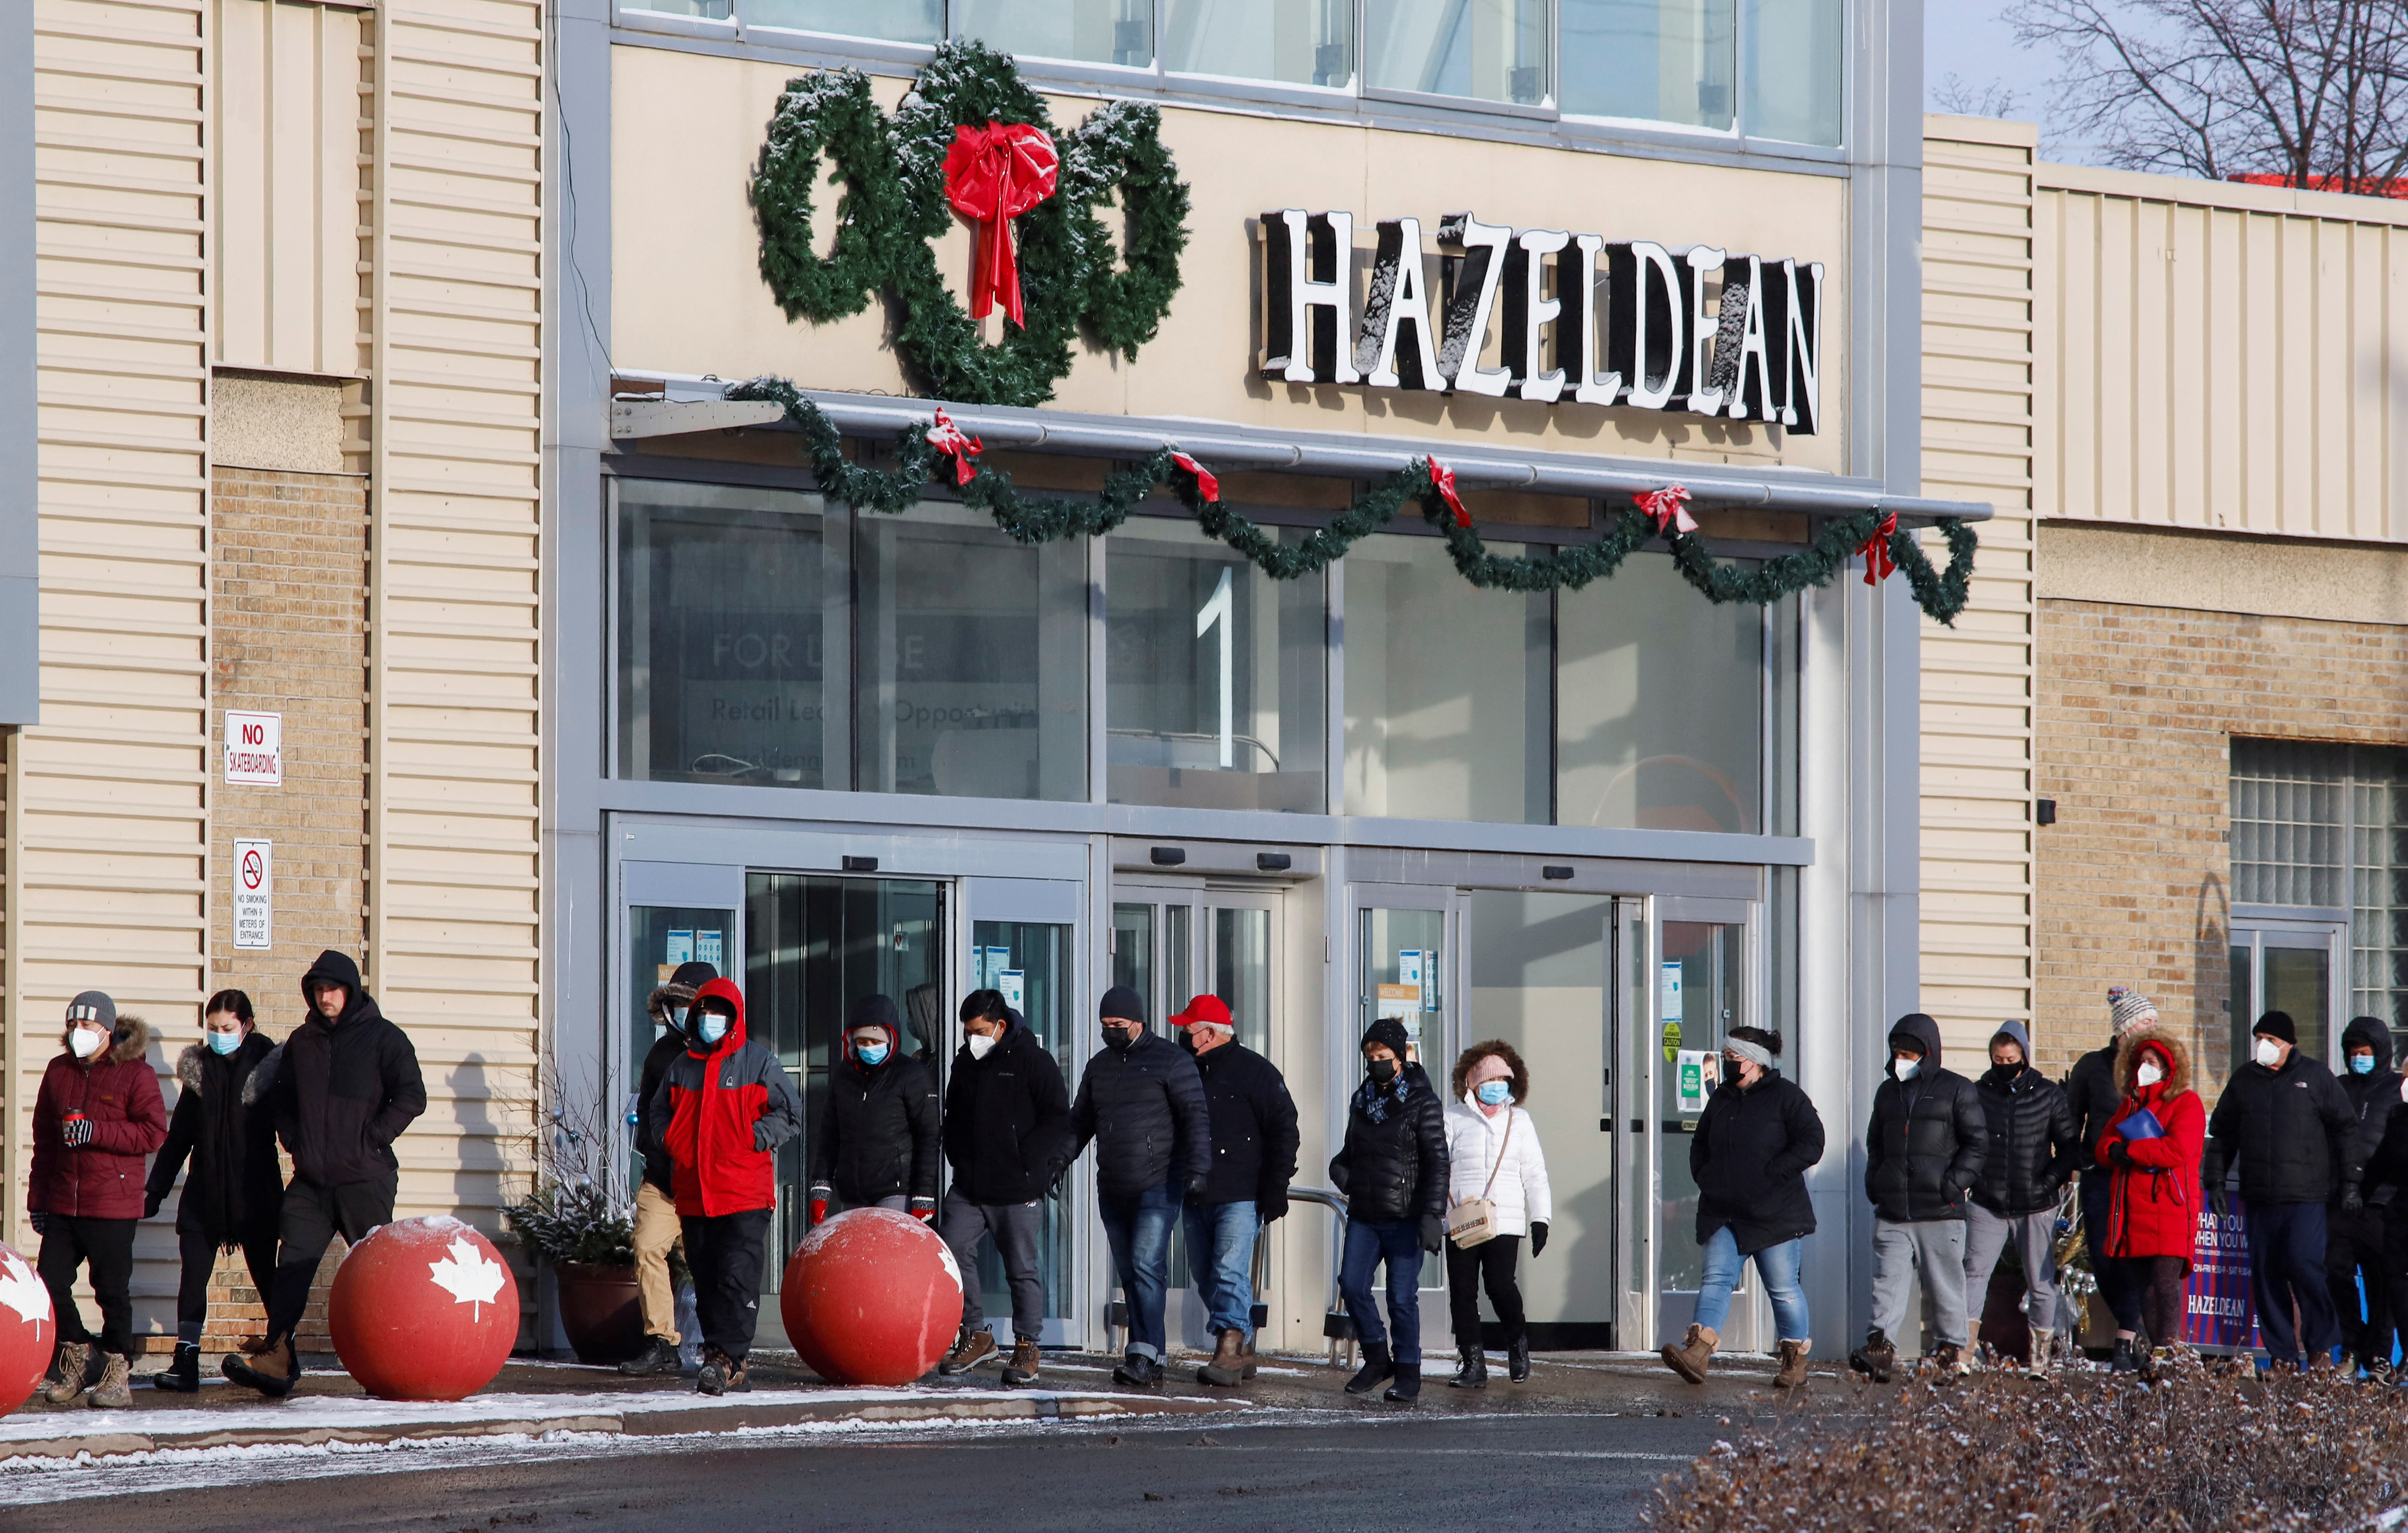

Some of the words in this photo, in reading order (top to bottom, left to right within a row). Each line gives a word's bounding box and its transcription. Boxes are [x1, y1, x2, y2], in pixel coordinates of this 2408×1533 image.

[1274, 209, 1824, 436] HAZELDEAN
[713, 633, 791, 668] FOR
[1197, 566, 1232, 767] 1
[711, 696, 780, 721] Retail
[243, 724, 263, 745] NO
[230, 752, 276, 774] SKATEBOARDING
[237, 894, 245, 903] NO
[246, 894, 267, 904] SMOKING
[242, 907, 258, 916] WITHIN
[259, 908, 262, 916] 9
[239, 919, 257, 929] METERS
[259, 920, 265, 929] OF
[240, 930, 264, 940] ENTRANCE
[659, 969, 675, 978] WELC
[1379, 987, 1404, 997] WELCOME!
[2197, 1212, 2218, 1229] HAT
[2219, 1232, 2238, 1248] YOU
[2193, 1263, 2211, 1272] ON-FRI
[2187, 1295, 2245, 1317] HAZELDEAN
